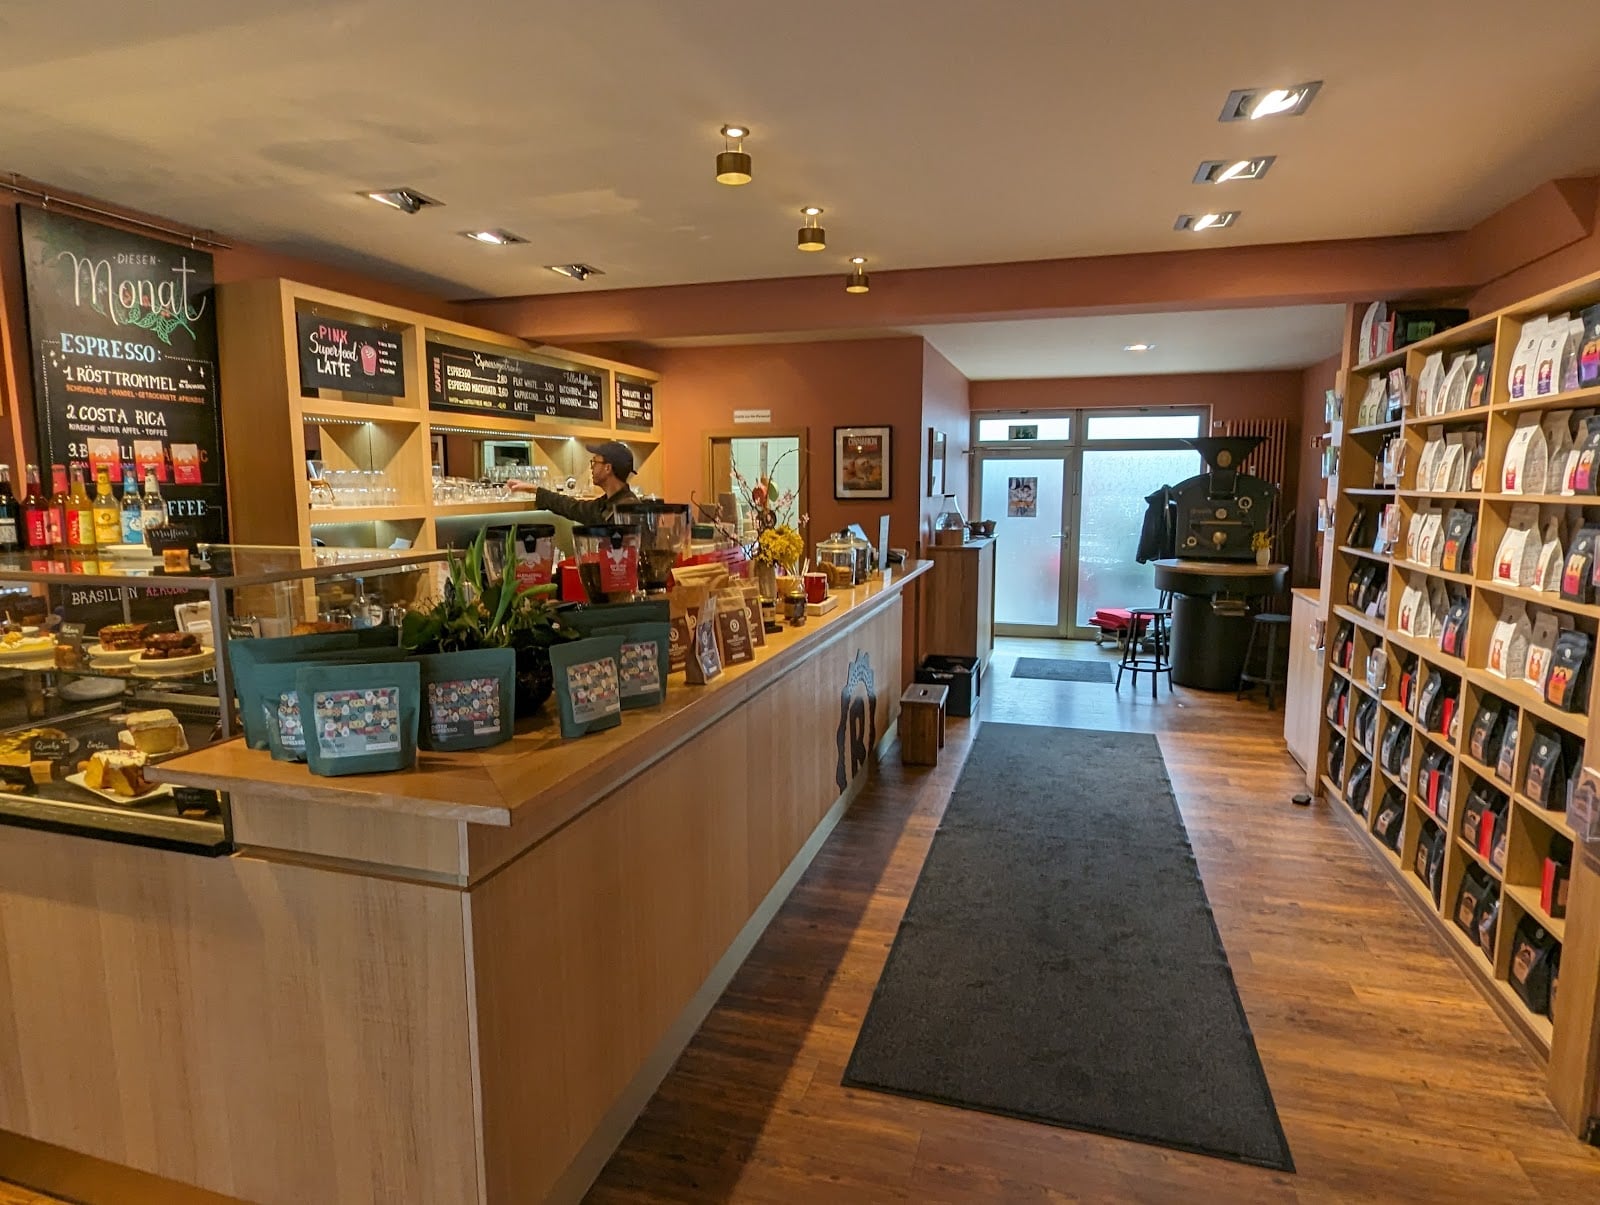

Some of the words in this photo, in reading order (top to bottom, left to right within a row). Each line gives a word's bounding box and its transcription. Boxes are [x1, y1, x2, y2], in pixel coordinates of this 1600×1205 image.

[57, 250, 207, 326] Monat
[318, 324, 348, 344] PINK
[308, 331, 358, 367] Superfood
[316, 358, 352, 378] LATTE
[446, 365, 472, 378] ESPRESSO
[65, 383, 108, 396] SCHOKOLADE
[111, 388, 136, 398] MANDEL
[447, 379, 471, 392] ESPRESSO
[78, 405, 129, 425] COSTA
[135, 409, 167, 427] RICA
[514, 402, 529, 412] LATTE
[68, 423, 96, 432] KIRSCHE
[121, 426, 141, 435] APFEL
[145, 428, 168, 437] TOFFEE
[71, 585, 138, 606] BRASILIN
